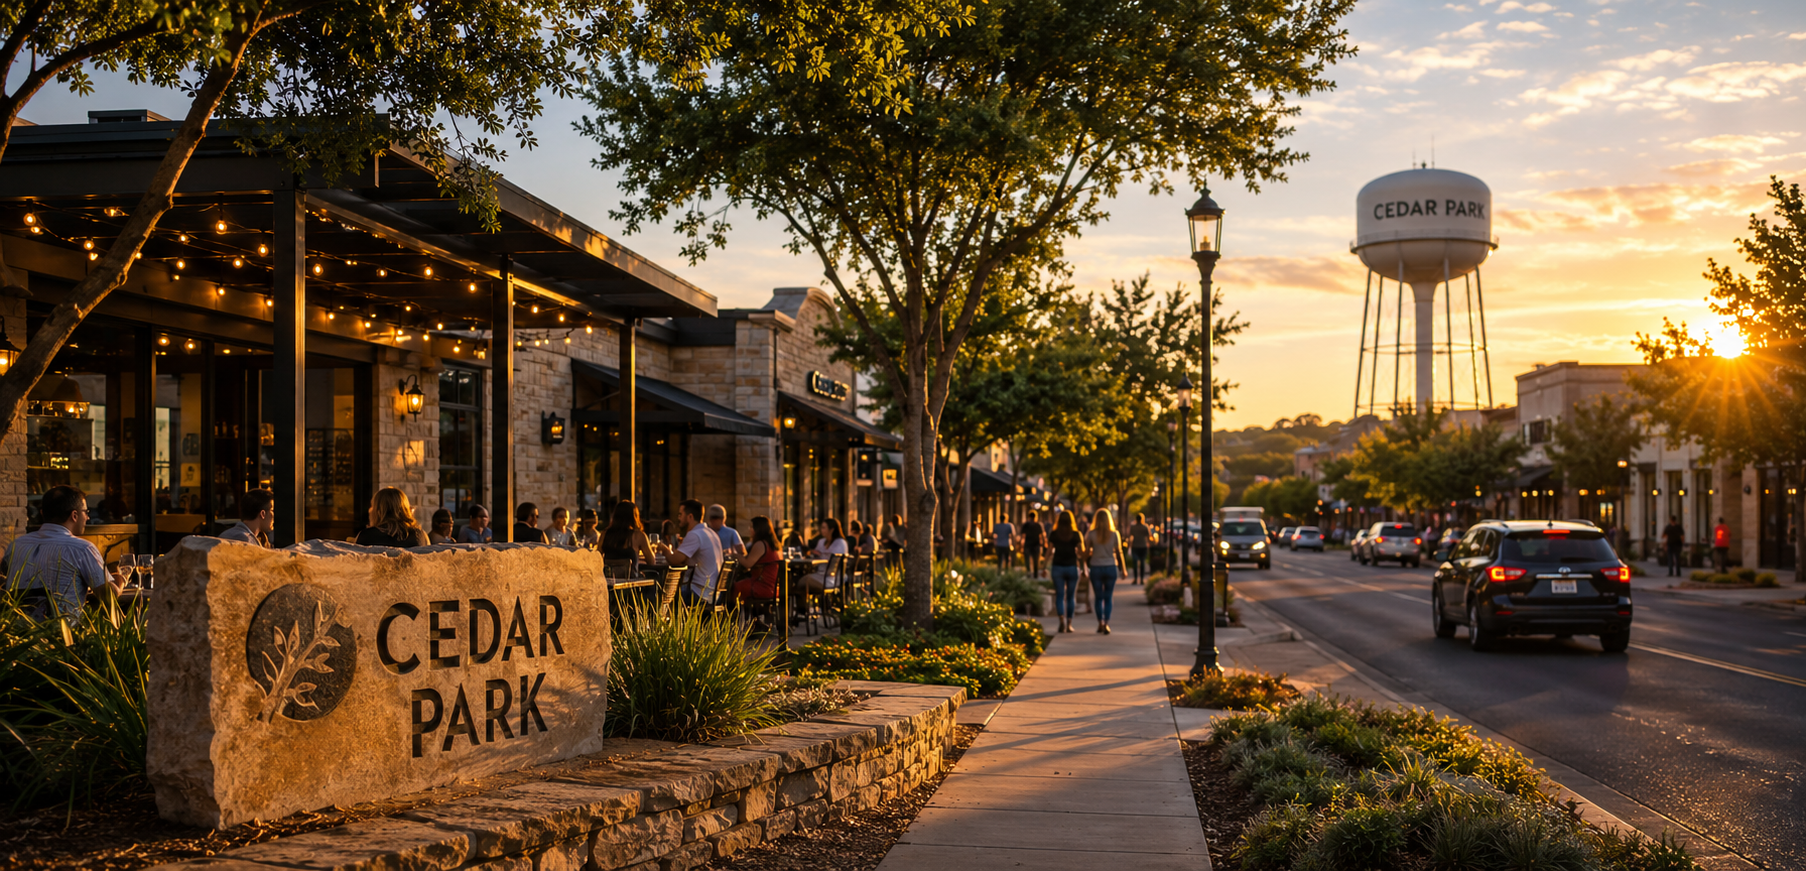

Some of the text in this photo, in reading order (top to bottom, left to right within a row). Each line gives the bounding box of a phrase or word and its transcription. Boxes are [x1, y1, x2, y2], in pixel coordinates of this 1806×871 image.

[1374, 200, 1485, 220] CEDAR PARK
[376, 595, 565, 675] CEDAR
[411, 672, 548, 758] PARK
